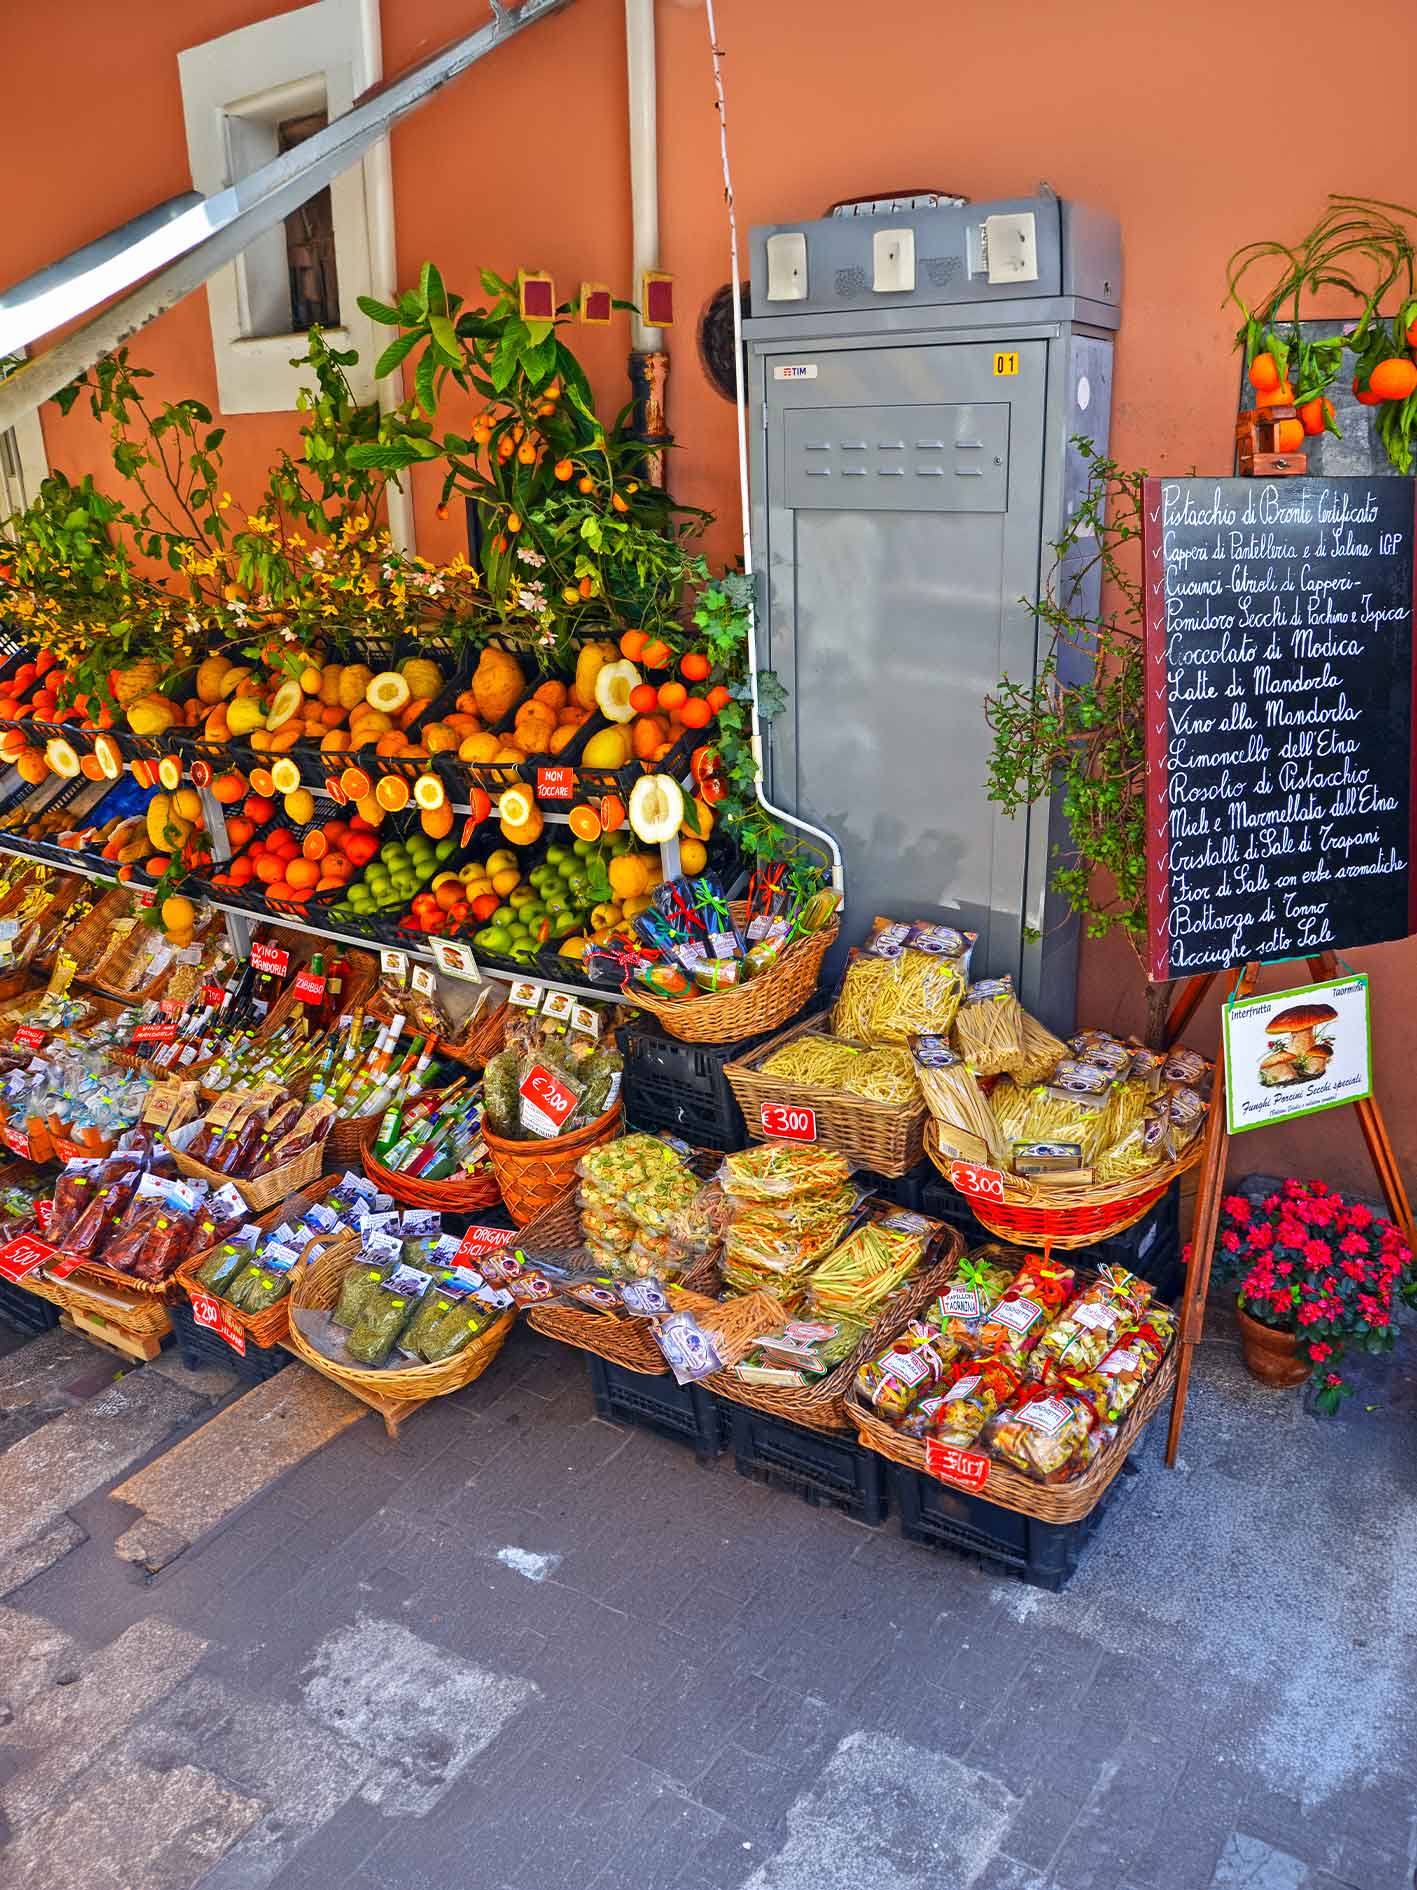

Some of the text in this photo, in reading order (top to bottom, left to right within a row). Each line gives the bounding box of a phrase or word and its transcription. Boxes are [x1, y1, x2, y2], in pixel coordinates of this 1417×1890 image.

[791, 367, 807, 377] TIM
[1163, 485, 1378, 530] Pistacchio di Bronte Certificato
[1164, 530, 1208, 570] Capperi
[1212, 531, 1225, 559] di
[1229, 532, 1298, 559] Pantelleria
[1303, 546, 1310, 557] e
[1317, 532, 1326, 556] di
[1331, 528, 1372, 557] Salina
[1281, 567, 1295, 591] di
[1166, 594, 1411, 632] Pomidoro Secchi di Pachino e Ispica
[1167, 629, 1364, 665] Cioccolato di Modica
[1168, 663, 1343, 702] Latte di Mandorla
[1168, 692, 1362, 734] Vino alla Mandorla
[1168, 734, 1271, 770] Limoncello
[537, 784, 568, 796] TOCCARE
[545, 770, 563, 782] NON
[1168, 756, 1370, 804] Rosolio di Pistacchio
[1169, 807, 1210, 838] Miele
[1214, 817, 1221, 831] e
[1228, 794, 1326, 829] Marmellata
[1168, 823, 1380, 871] Cristalli di Sale di Trapani
[1172, 848, 1408, 903] Fior di Sale con erbe aromatiche
[1168, 893, 1328, 939] Bottarga di Tonno
[256, 944, 278, 959] VINO
[1168, 917, 1336, 968] Acciughe sotto Sale
[251, 958, 288, 977] MANDORLA
[295, 977, 325, 994] ZIBIBBO
[1231, 1004, 1271, 1020] Interfrutta
[1241, 1100, 1270, 1116] Funghi
[1273, 1092, 1303, 1105] Porcini
[1306, 1081, 1331, 1097] Secchi
[1332, 1073, 1361, 1090] speciali
[945, 1301, 976, 1312] TAORMINA
